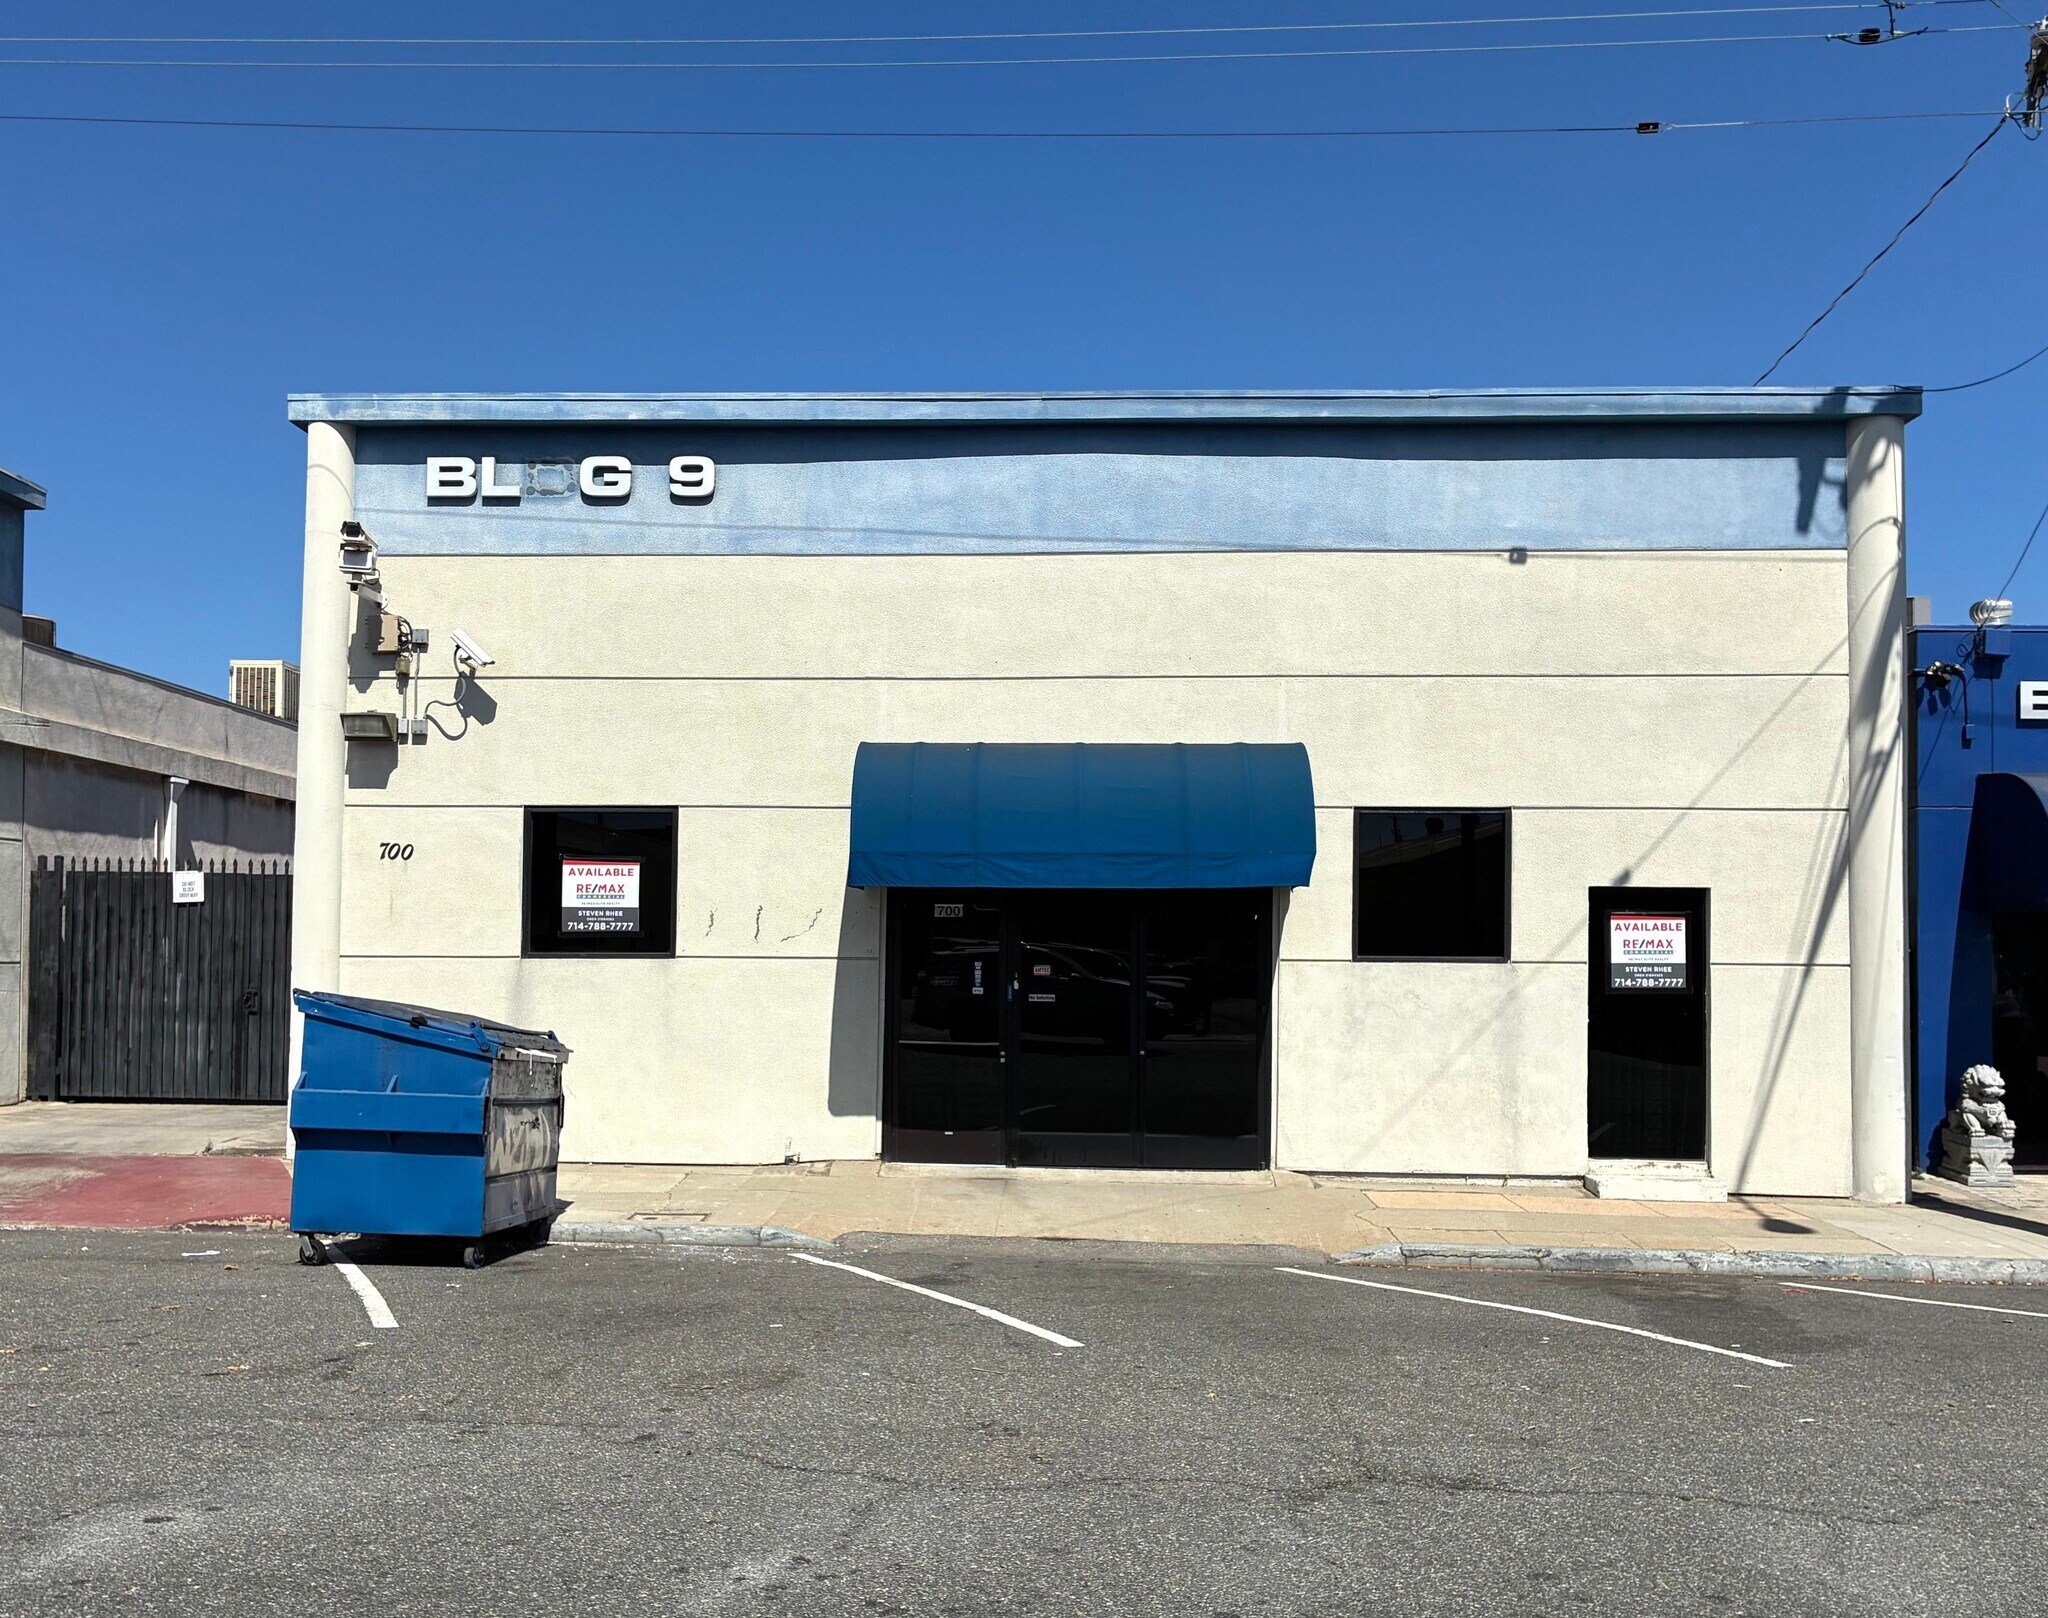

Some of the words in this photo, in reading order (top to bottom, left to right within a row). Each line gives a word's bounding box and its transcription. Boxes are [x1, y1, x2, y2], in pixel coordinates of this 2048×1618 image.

[669, 455, 715, 497] 9
[380, 842, 414, 861] 700
[568, 868, 634, 877] AVAILABLE
[576, 884, 625, 893] RE/MAX
[937, 905, 960, 916] 700
[567, 922, 634, 931] 714-788-7777
[1614, 923, 1682, 931] AVAILABLE
[1623, 939, 1673, 949] RE/MAX
[1614, 978, 1684, 987] 714-788-7777
